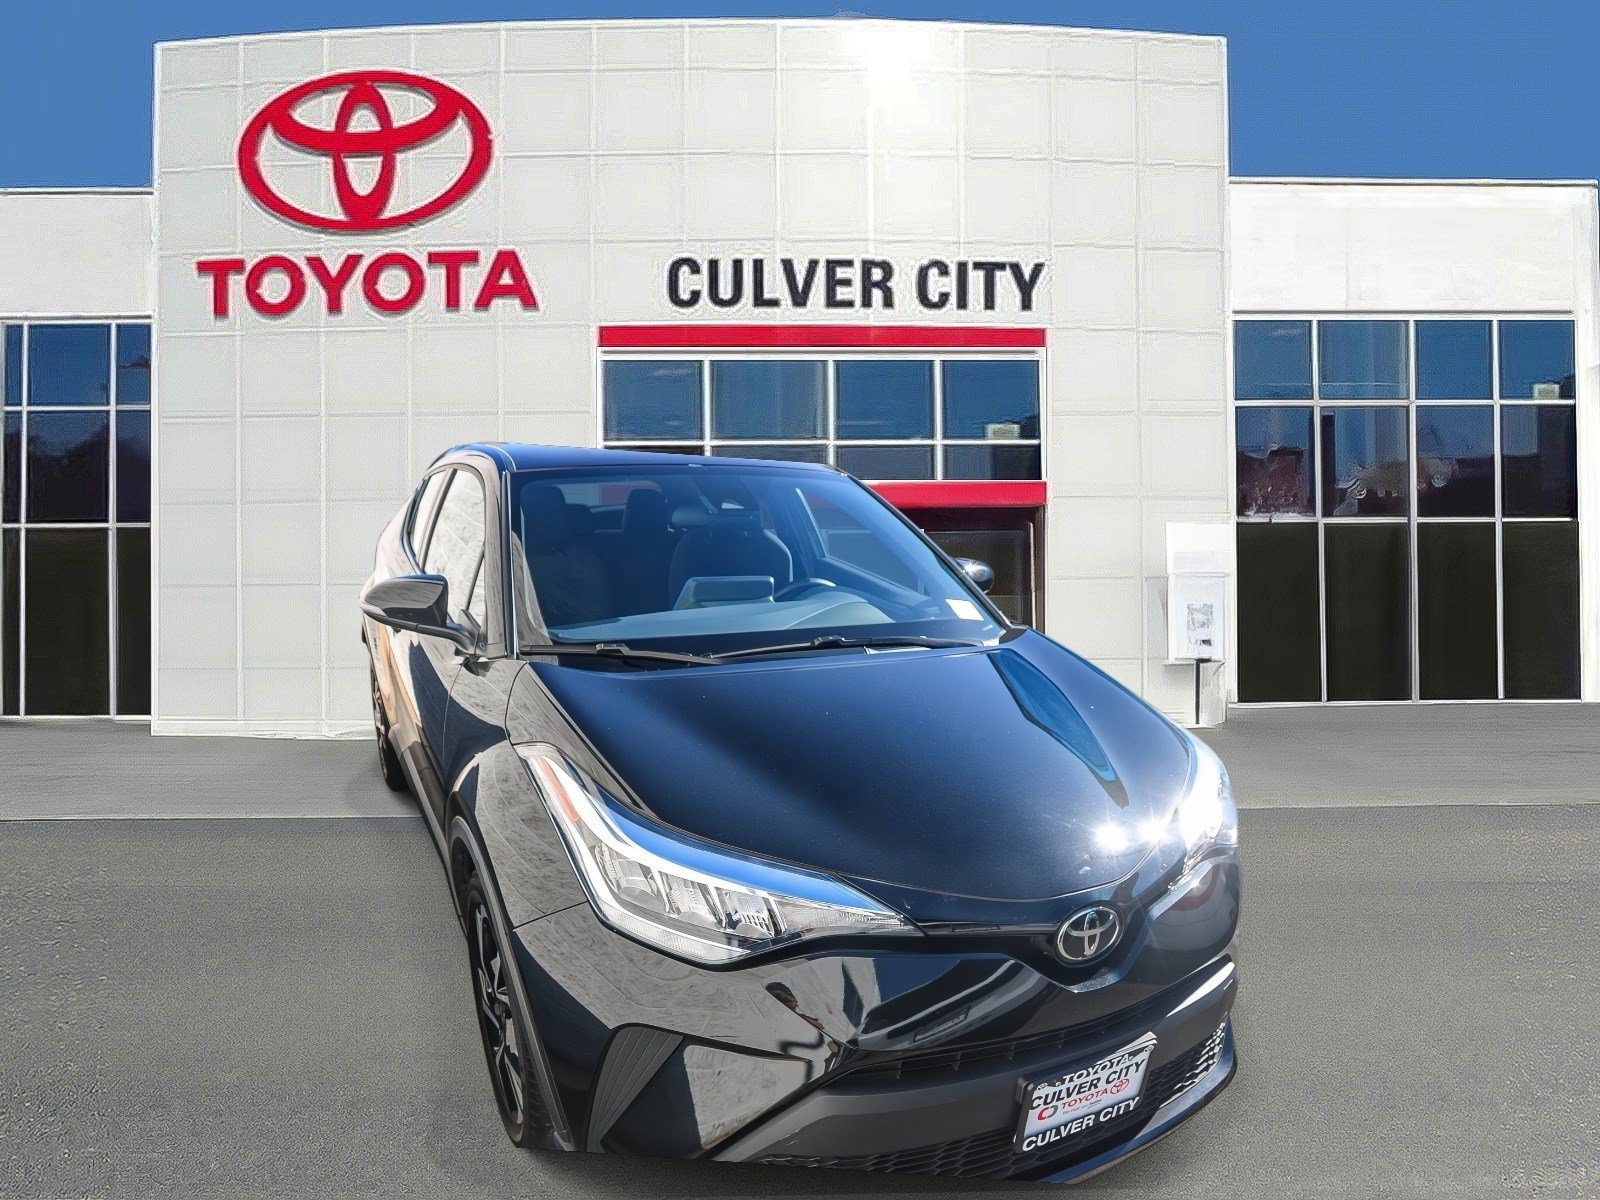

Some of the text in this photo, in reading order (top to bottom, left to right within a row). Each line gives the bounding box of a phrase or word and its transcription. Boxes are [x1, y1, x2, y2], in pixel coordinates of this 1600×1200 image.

[196, 250, 539, 318] TOYOTA
[667, 257, 1045, 311] CULVER CITY
[1032, 1076, 1101, 1109] CULVER
[1105, 1059, 1146, 1084] CITY
[1062, 1053, 1131, 1085] TOYOTA
[1022, 1114, 1096, 1152] CULVER
[1099, 1096, 1140, 1122] CITY
[1062, 1087, 1108, 1109] TOYOTA
